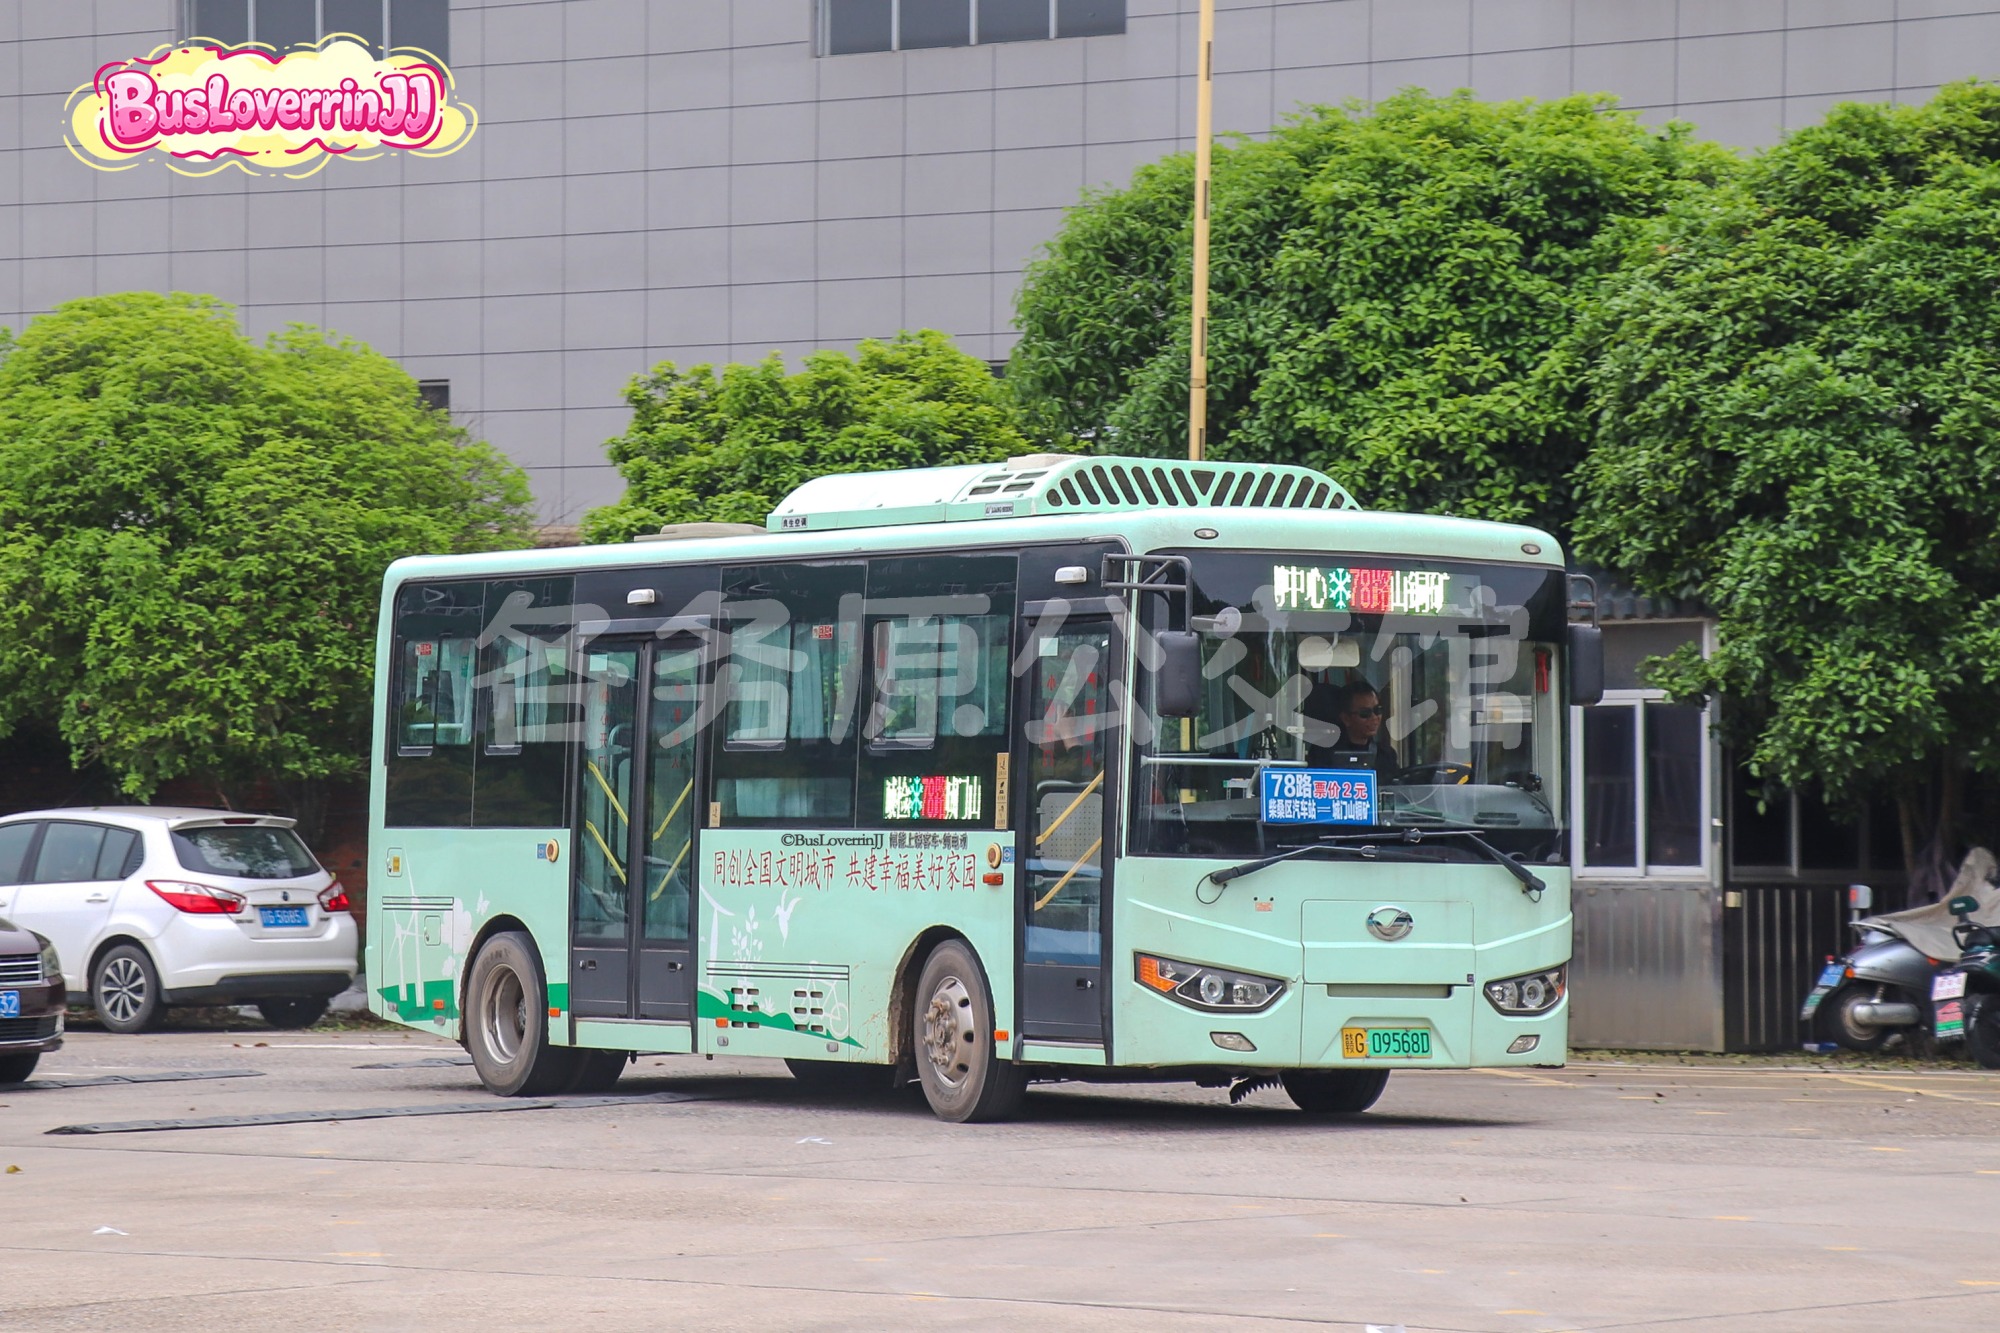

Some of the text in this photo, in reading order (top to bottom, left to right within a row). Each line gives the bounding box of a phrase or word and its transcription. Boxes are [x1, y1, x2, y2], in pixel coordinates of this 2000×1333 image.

[1270, 774, 1369, 799] 78路 票价2元
[714, 848, 977, 894] 同创全国文明城市 共建幸福美好家园
